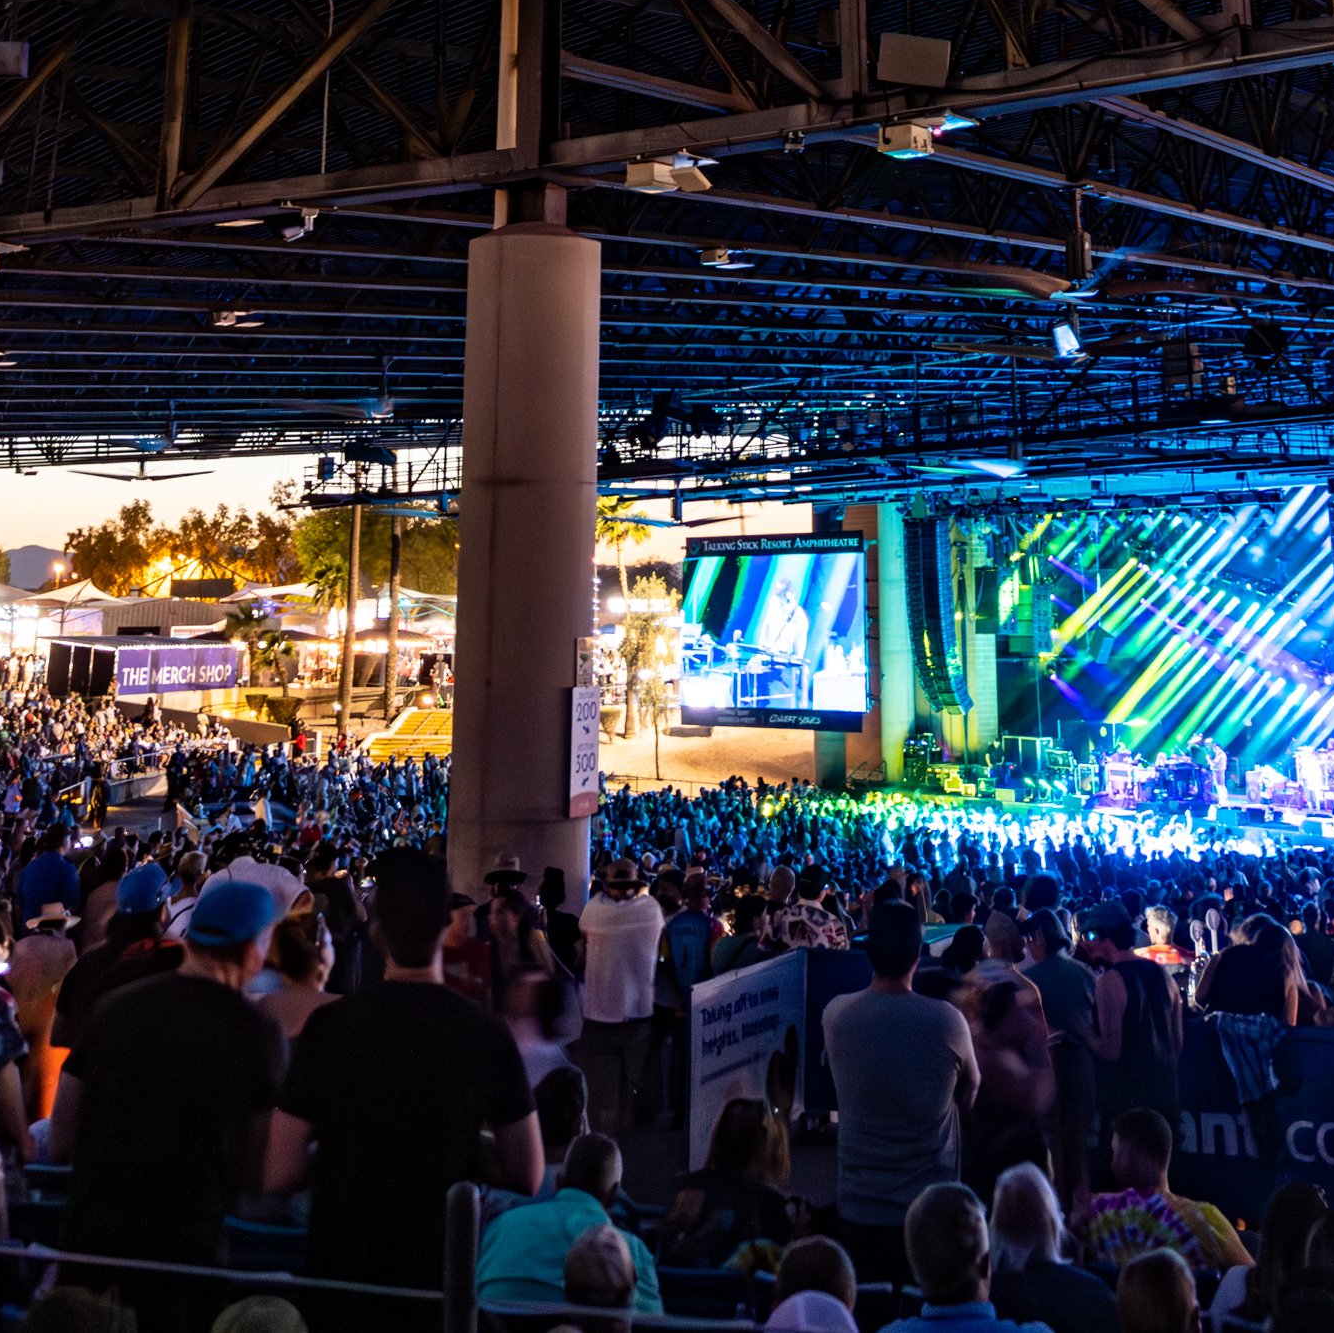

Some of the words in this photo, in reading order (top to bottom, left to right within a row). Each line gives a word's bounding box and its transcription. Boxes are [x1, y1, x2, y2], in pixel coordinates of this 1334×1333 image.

[122, 667, 148, 686] THE
[151, 665, 196, 684] MERCH
[199, 664, 232, 683] SHOP
[575, 701, 597, 723] 200
[575, 752, 596, 774] 300
[733, 992, 748, 1015] off
[748, 992, 759, 1009] to
